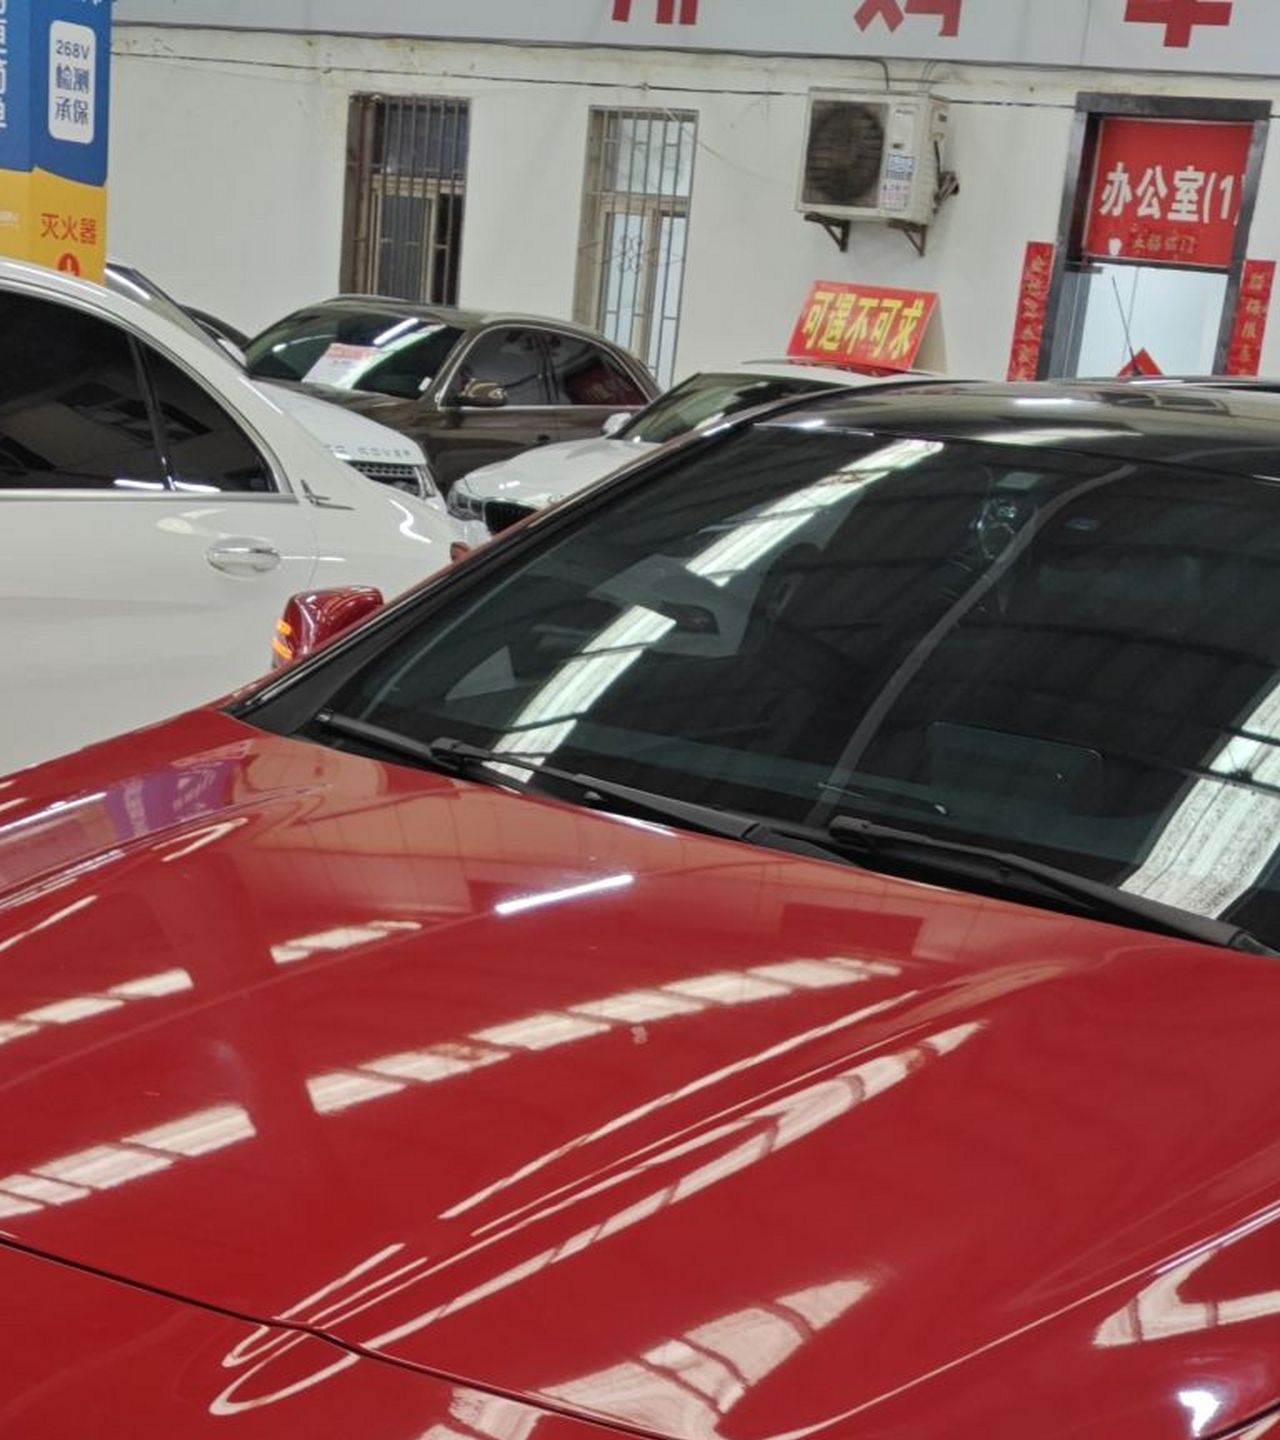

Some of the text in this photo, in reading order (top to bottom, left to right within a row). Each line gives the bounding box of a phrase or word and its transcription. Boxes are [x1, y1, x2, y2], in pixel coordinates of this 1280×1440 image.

[56, 39, 90, 60] 268V
[54, 96, 90, 126] 承保
[40, 212, 97, 246] 灭火器
[802, 290, 925, 360] 可遇不可求
